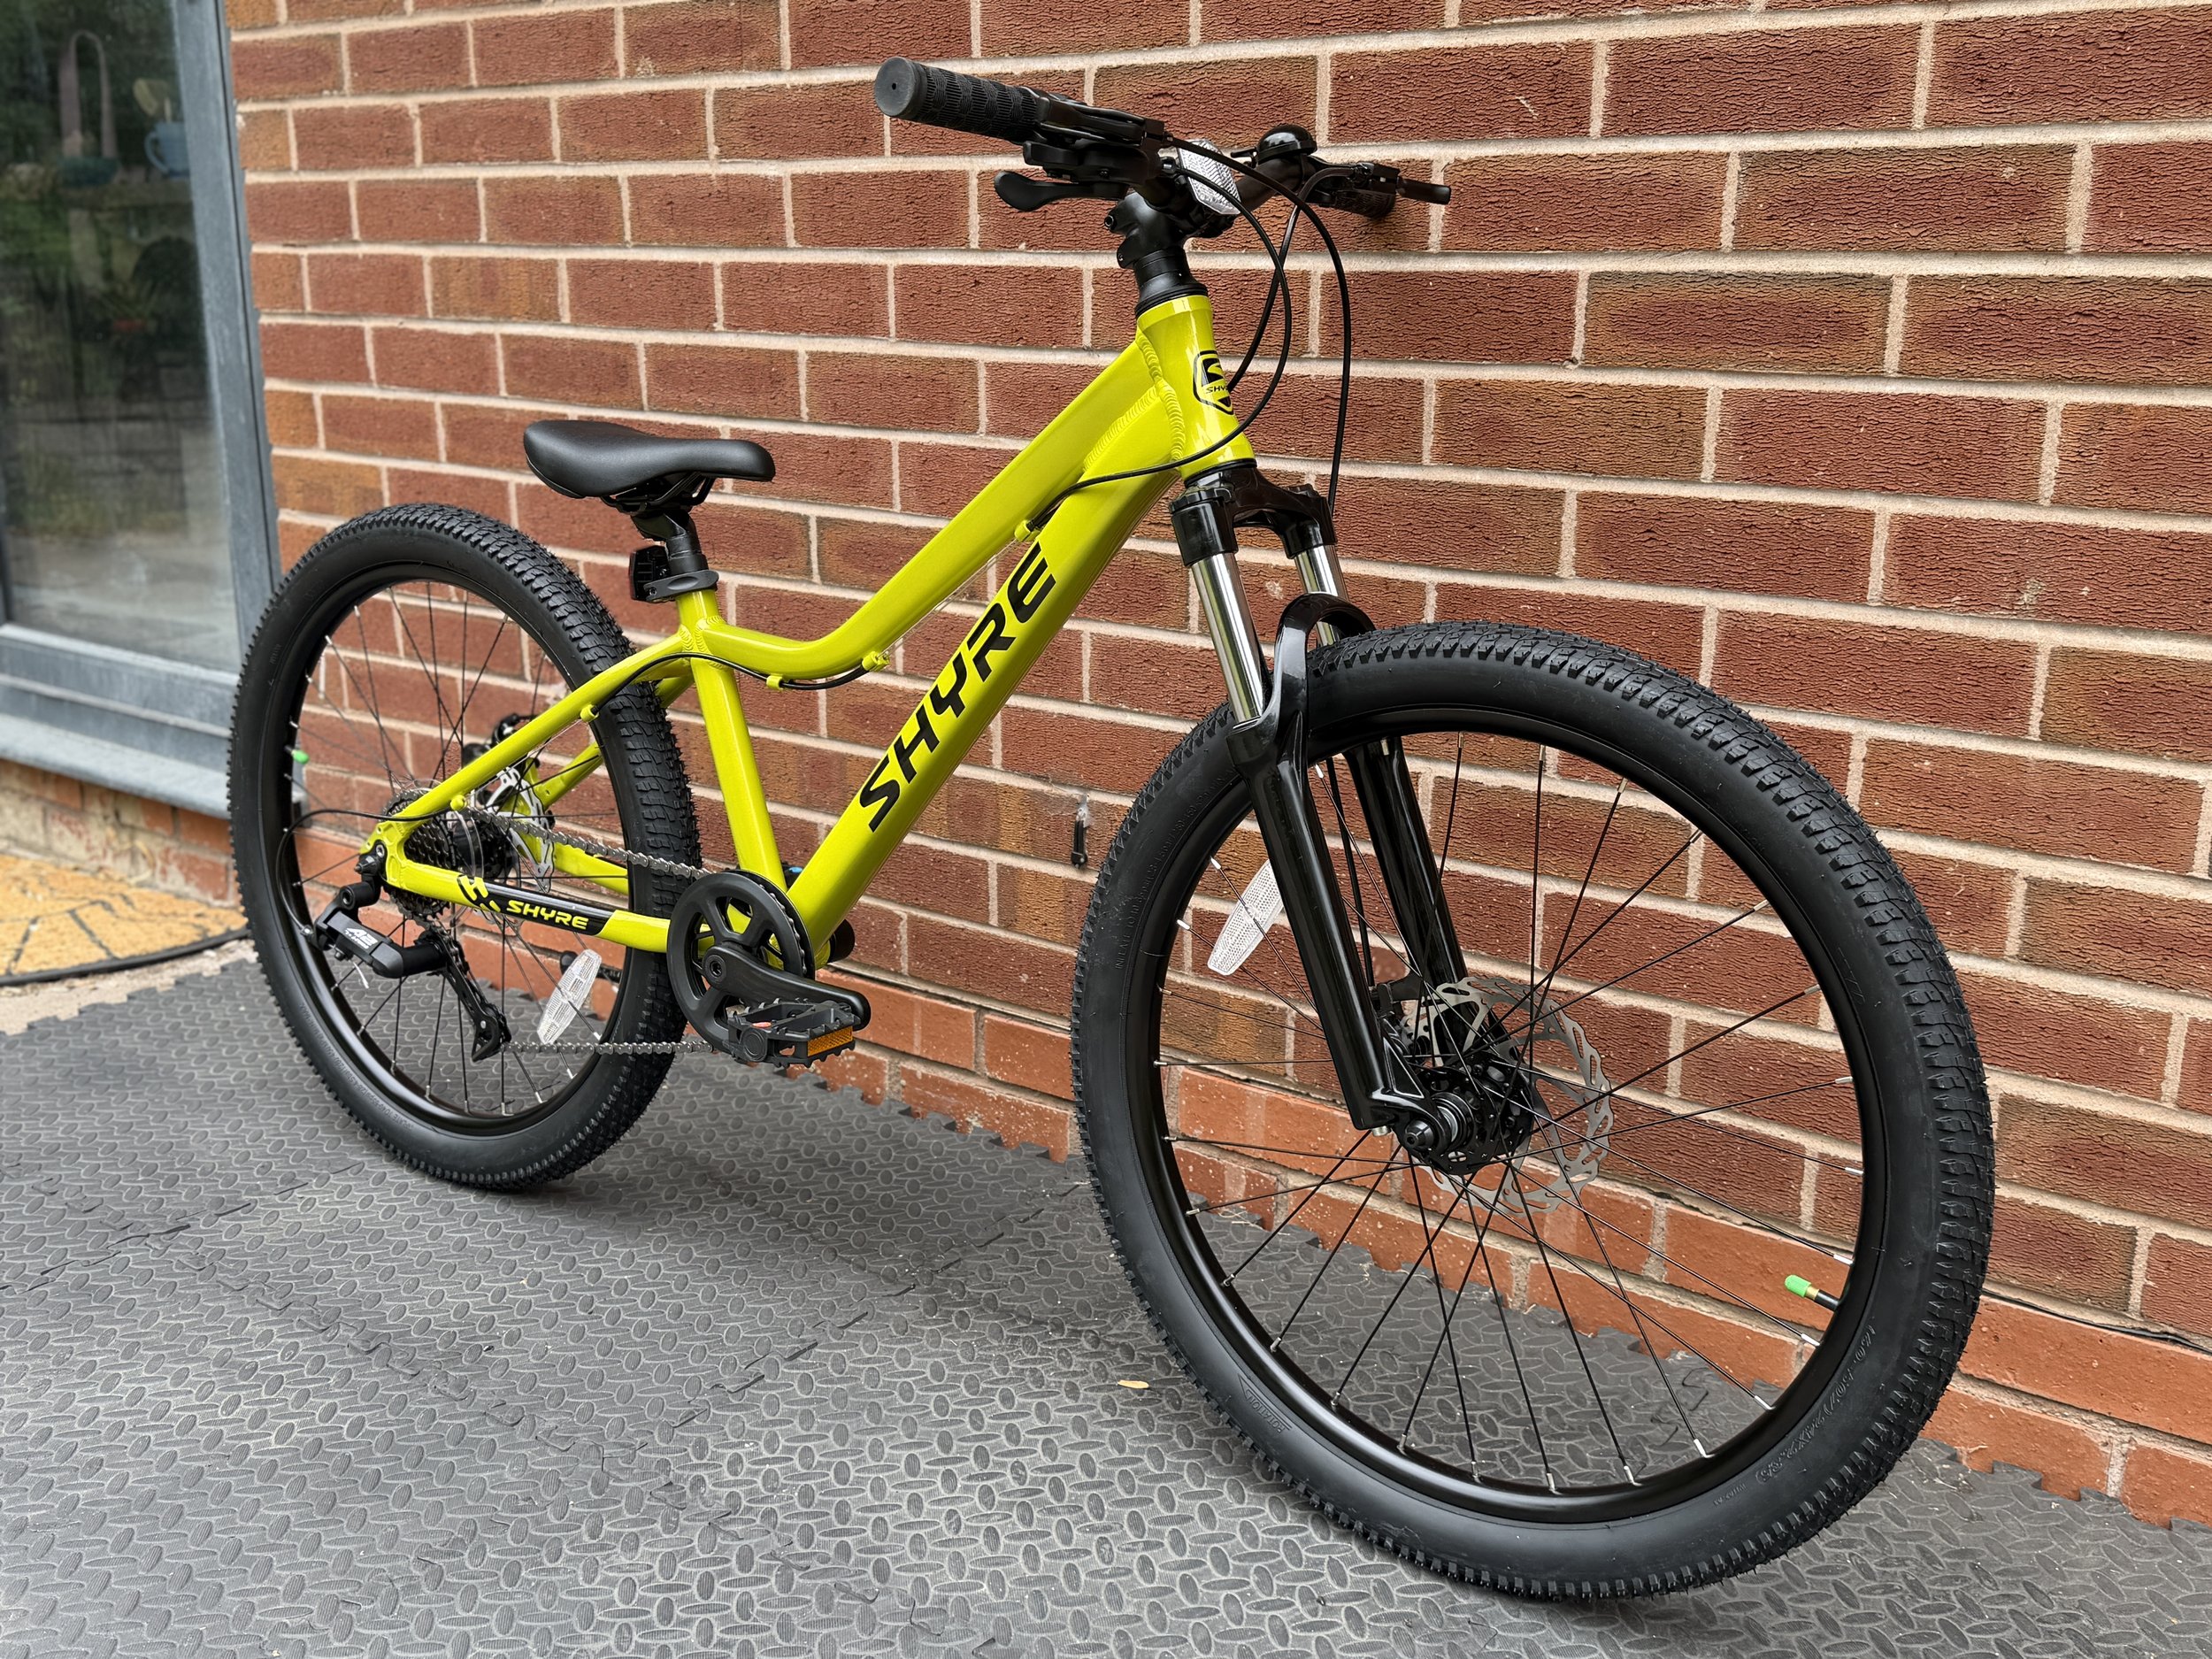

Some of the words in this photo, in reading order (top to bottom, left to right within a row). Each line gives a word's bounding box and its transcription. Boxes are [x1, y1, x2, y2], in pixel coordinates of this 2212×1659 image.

[1206, 385, 1229, 395] SHY
[859, 541, 1056, 833] SHYRE
[506, 899, 588, 930] SHYRE
[1247, 1395, 1286, 1434] ROTATION
